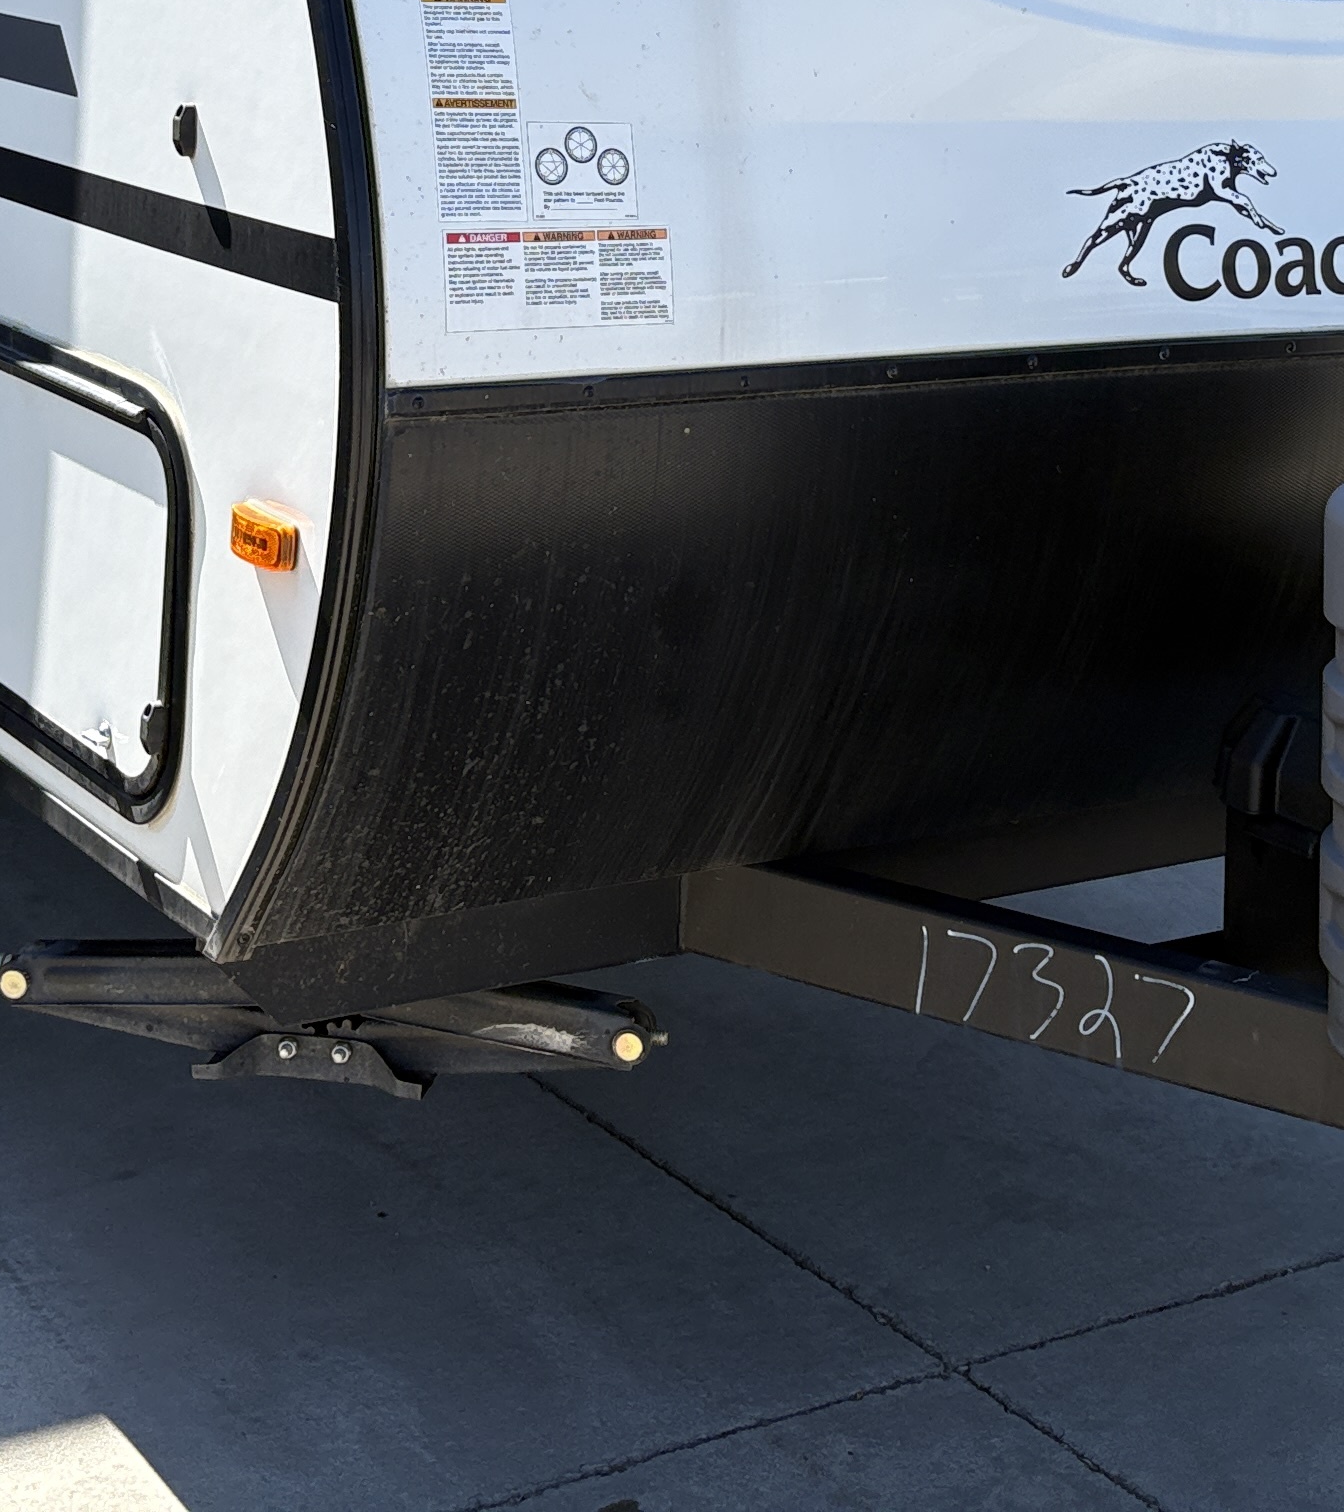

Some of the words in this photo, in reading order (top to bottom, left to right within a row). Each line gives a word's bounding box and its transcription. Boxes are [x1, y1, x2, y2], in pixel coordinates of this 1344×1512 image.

[444, 99, 514, 108] AVERTISSEMENT
[469, 233, 508, 243] DANGER
[543, 232, 584, 241] WARNING
[617, 230, 657, 239] WARNING
[914, 924, 1196, 1064] 17327
